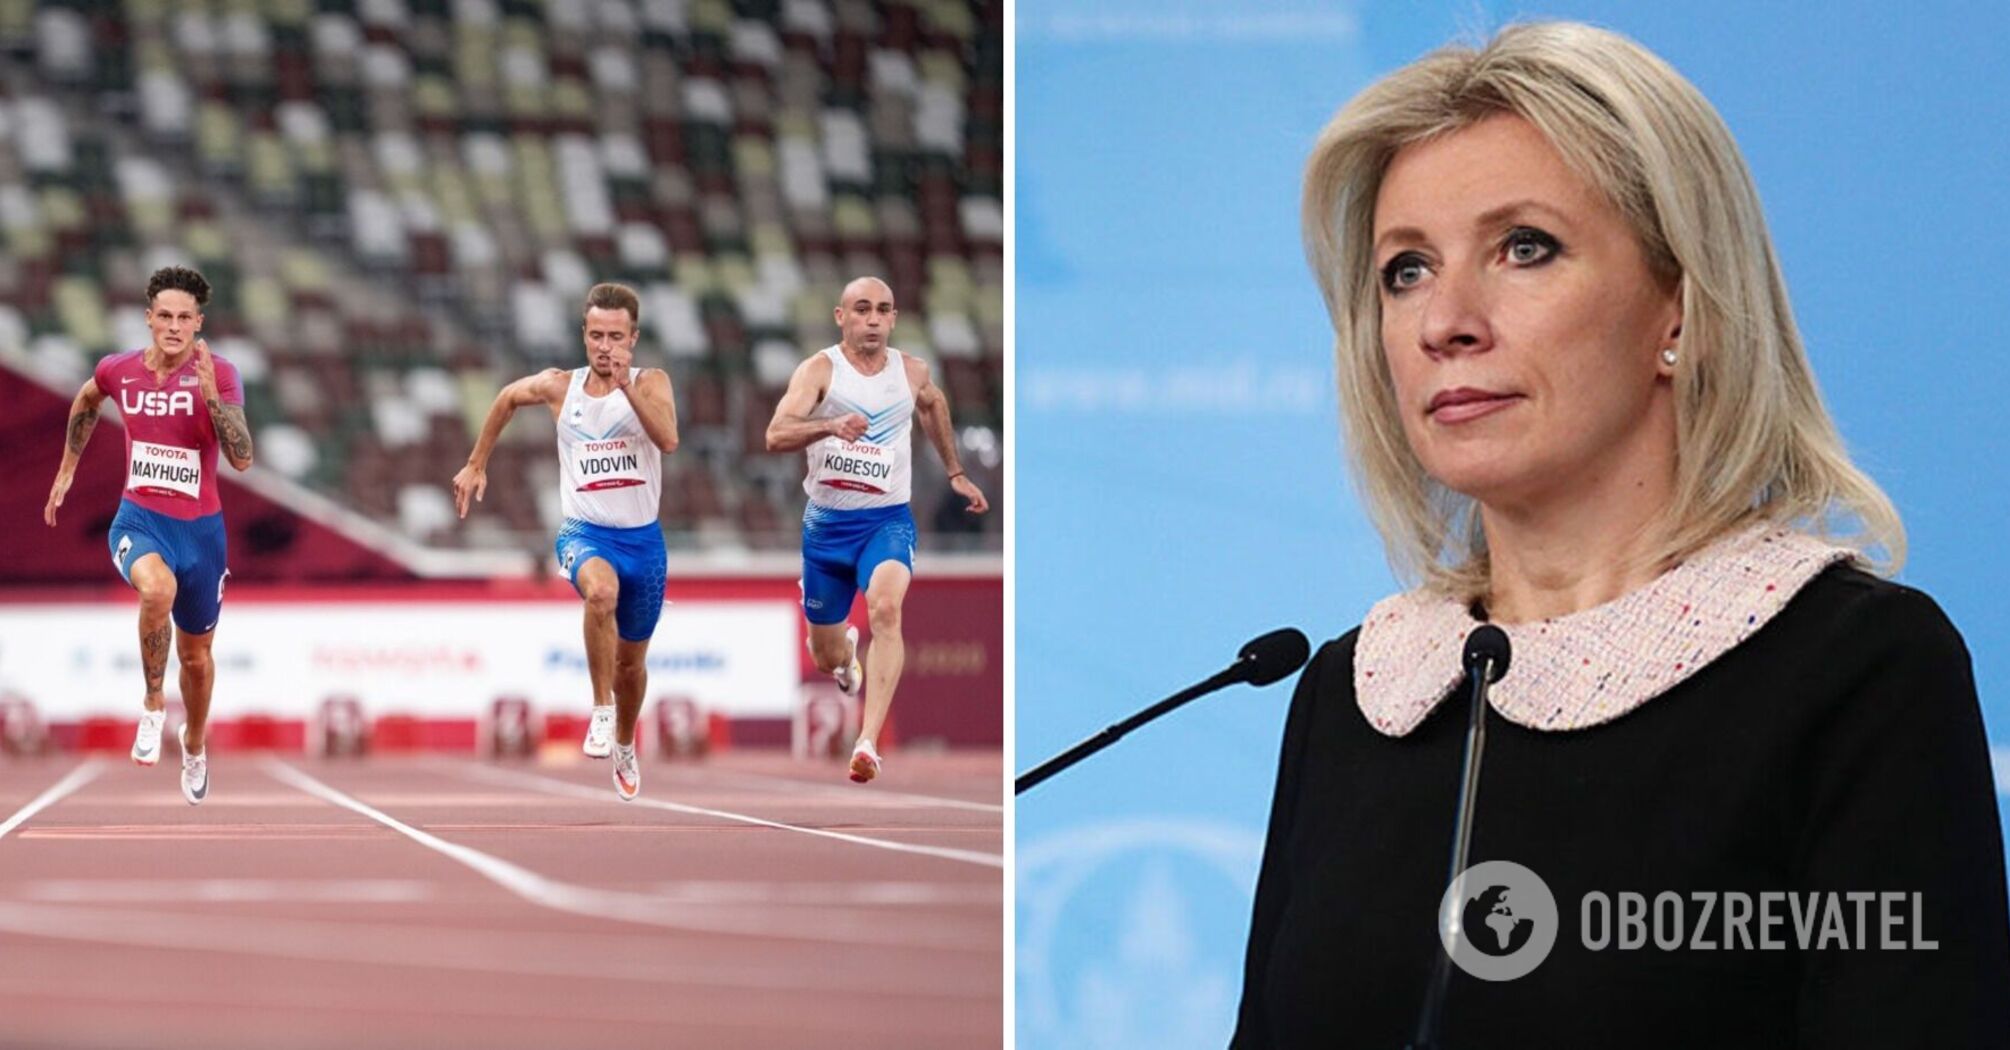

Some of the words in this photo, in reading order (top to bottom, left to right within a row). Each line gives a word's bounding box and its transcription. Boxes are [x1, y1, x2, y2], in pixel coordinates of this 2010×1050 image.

[121, 388, 194, 416] USA
[145, 445, 188, 460] TOYOTA
[585, 440, 627, 452] TOYOTA
[841, 442, 882, 457] TOYOTA
[131, 459, 199, 485] MAYHUGH
[580, 453, 638, 475] VDOVIN
[824, 453, 891, 479] KOBESOV
